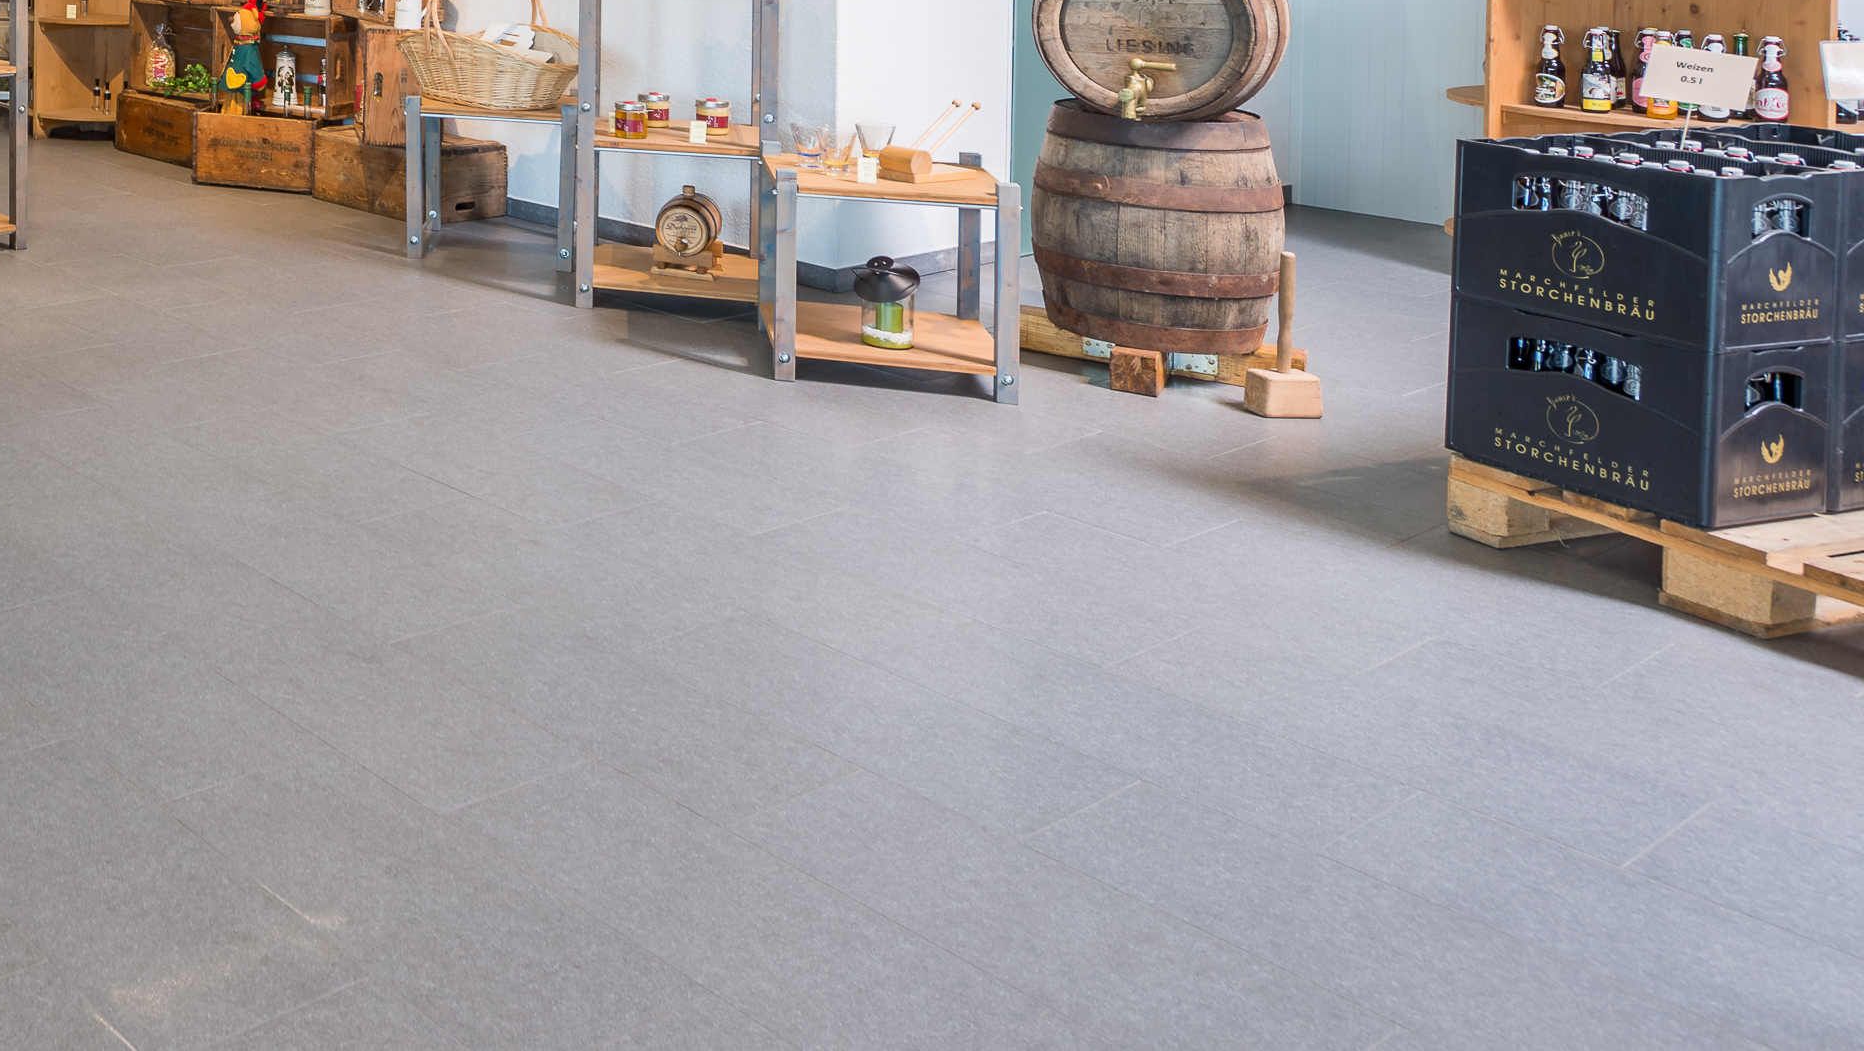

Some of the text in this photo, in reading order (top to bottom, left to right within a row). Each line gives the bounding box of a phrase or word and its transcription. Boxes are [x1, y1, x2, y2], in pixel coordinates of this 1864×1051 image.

[1105, 38, 1195, 55] LIESING
[1676, 61, 1714, 73] Weizen
[1680, 75, 1697, 85] 0.5
[1499, 268, 1655, 307] MARCHFELDER
[1499, 278, 1655, 321] STORCHENBRÄU
[1740, 307, 1819, 325] STORCHENBRÄU
[1494, 436, 1649, 491] STORCHENBRÄU
[1495, 427, 1649, 478] MARCHFELDER
